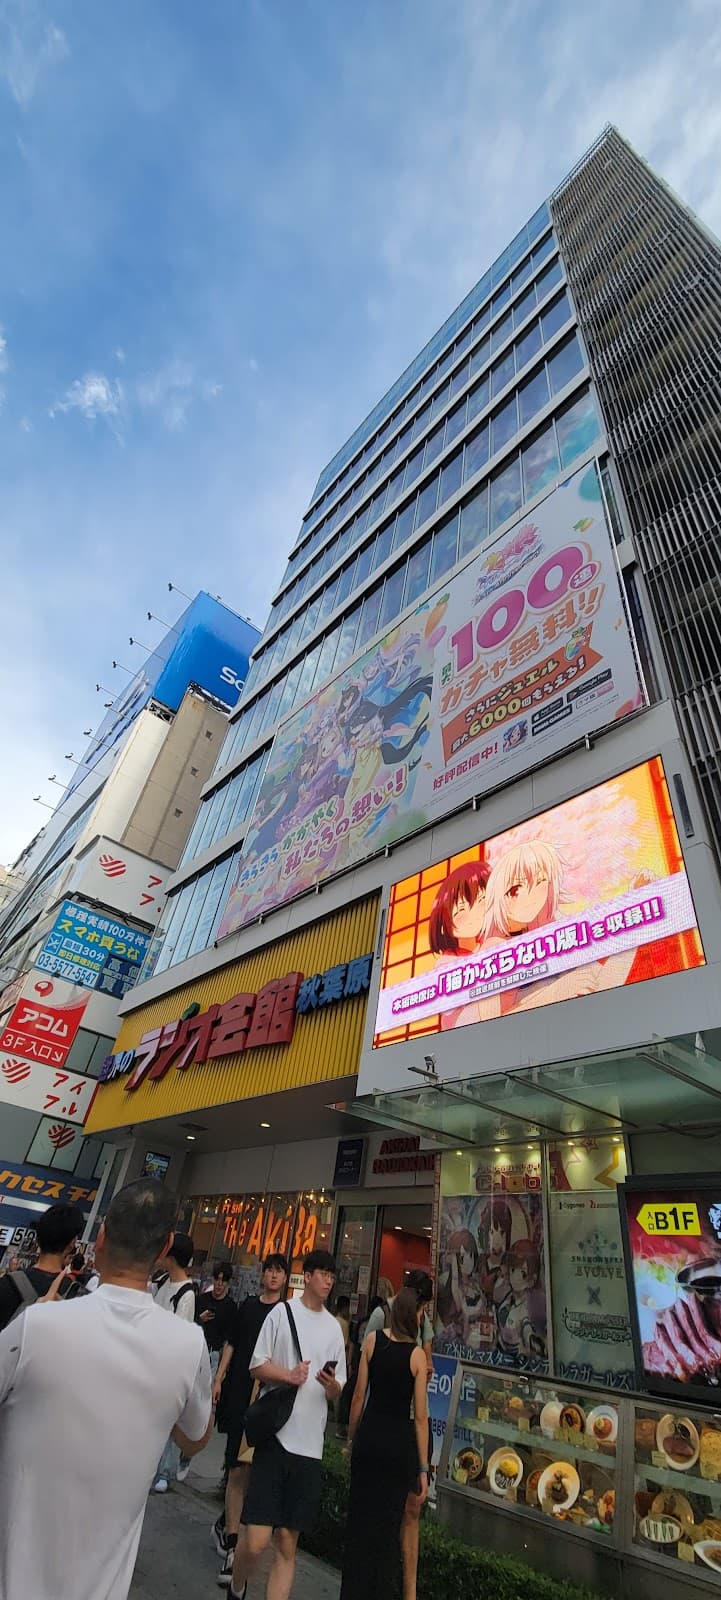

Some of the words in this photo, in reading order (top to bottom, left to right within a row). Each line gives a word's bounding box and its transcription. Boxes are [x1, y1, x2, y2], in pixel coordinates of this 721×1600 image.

[452, 545, 583, 673] 100
[440, 586, 600, 714] ガチャ無料!!
[465, 659, 560, 723] さらにジュエル
[433, 742, 499, 791] 好評配信中!
[57, 918, 141, 961] スマホ買うな
[82, 945, 106, 962] 30分
[37, 953, 98, 985] 03-5577-5547
[18, 1007, 70, 1037] アコム
[124, 971, 304, 1091] ラジオ会館
[296, 951, 374, 1015] 秋葉原
[2, 1033, 53, 1058] 3F入口
[654, 1207, 695, 1231] B1F
